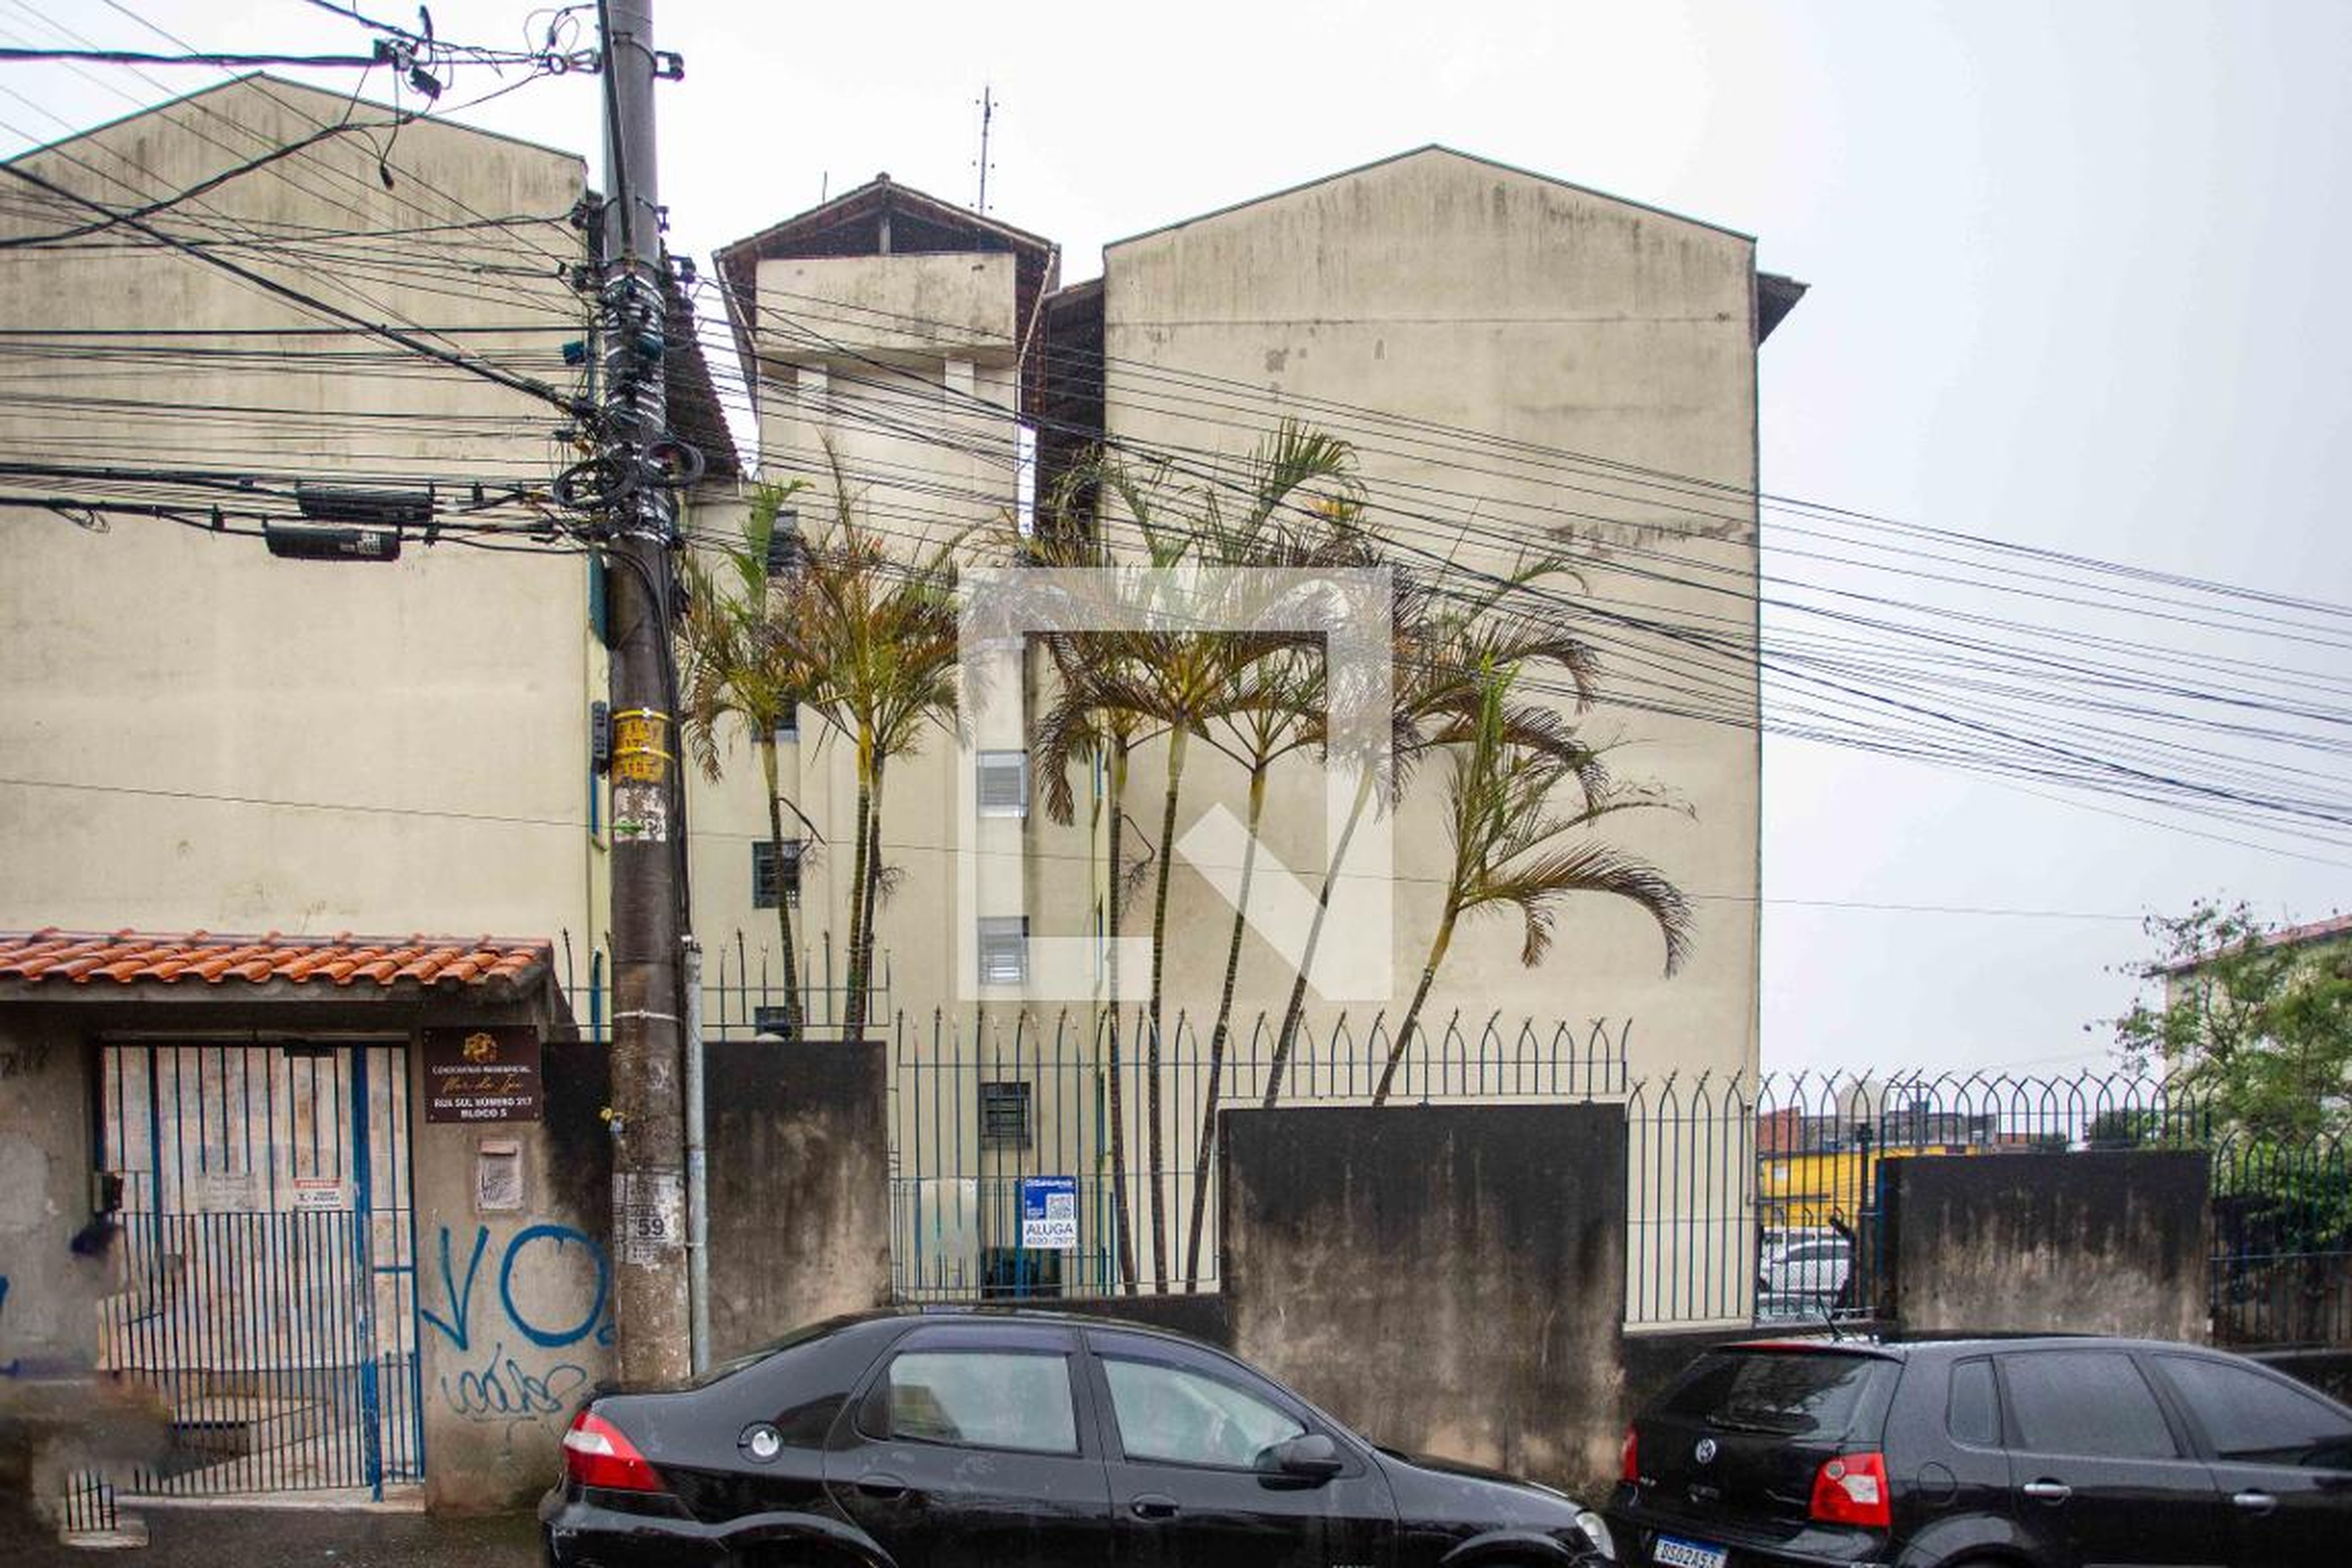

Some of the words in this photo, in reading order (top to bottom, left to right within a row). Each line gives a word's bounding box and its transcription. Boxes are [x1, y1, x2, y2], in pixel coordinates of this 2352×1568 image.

[461, 1109, 498, 1118] BLOCO
[638, 1218, 664, 1236] 59
[1027, 1223, 1072, 1235] ALUGA
